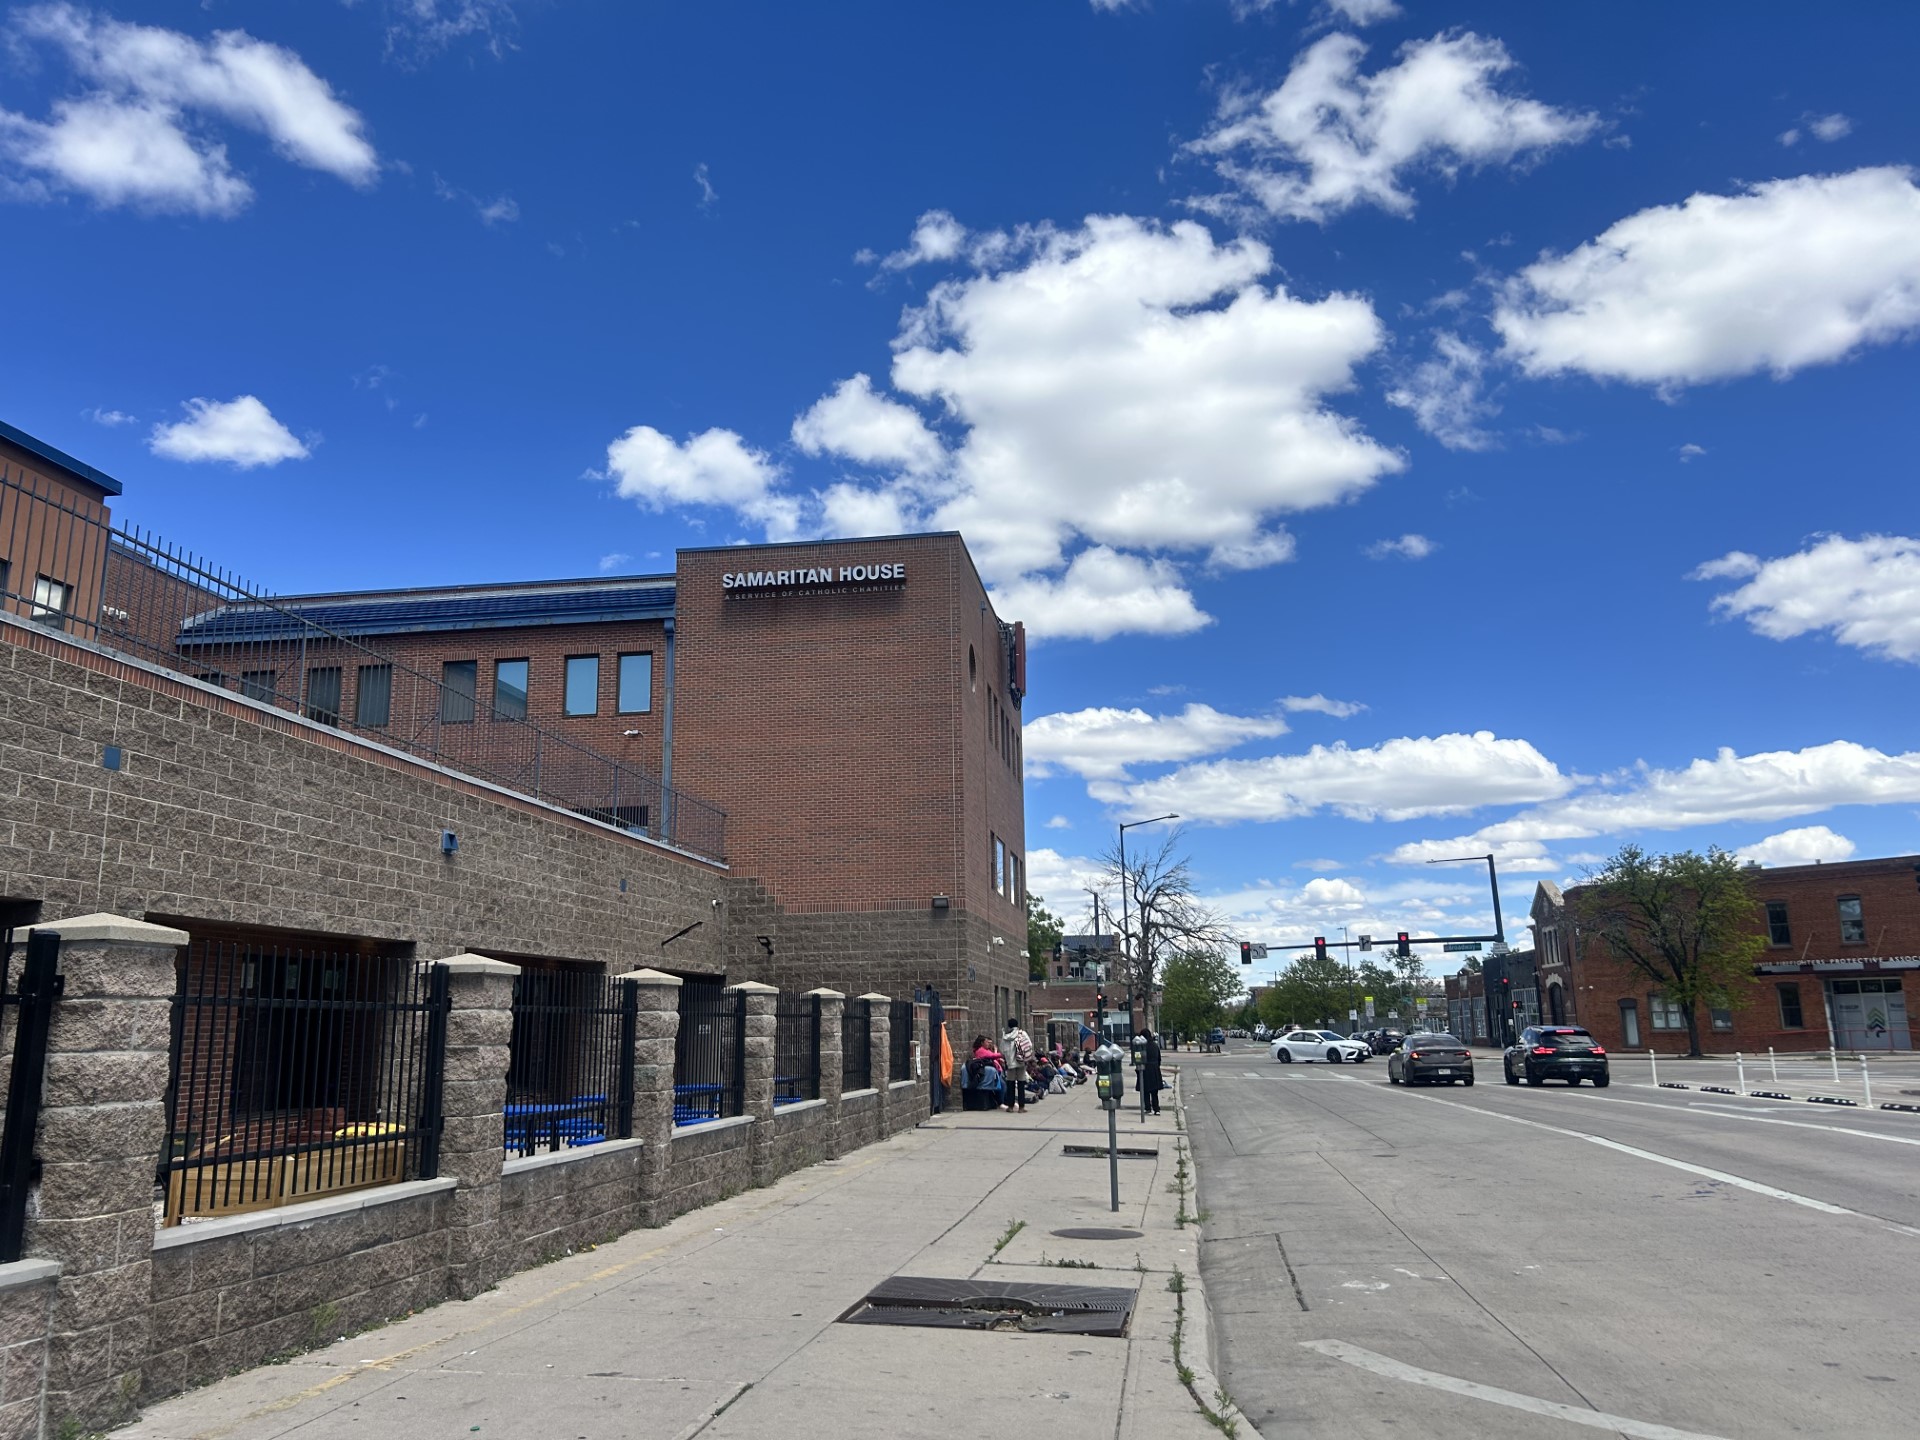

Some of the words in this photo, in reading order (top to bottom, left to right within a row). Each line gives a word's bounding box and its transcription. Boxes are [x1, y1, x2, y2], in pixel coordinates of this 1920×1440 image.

[722, 567, 832, 588] SAMARITAN
[839, 563, 905, 581] HOUSE
[735, 591, 776, 600] SERVICE
[798, 587, 847, 596] CATHOLIC
[852, 584, 906, 593] CHARITIES
[1830, 956, 1883, 964] PROTECTIVE
